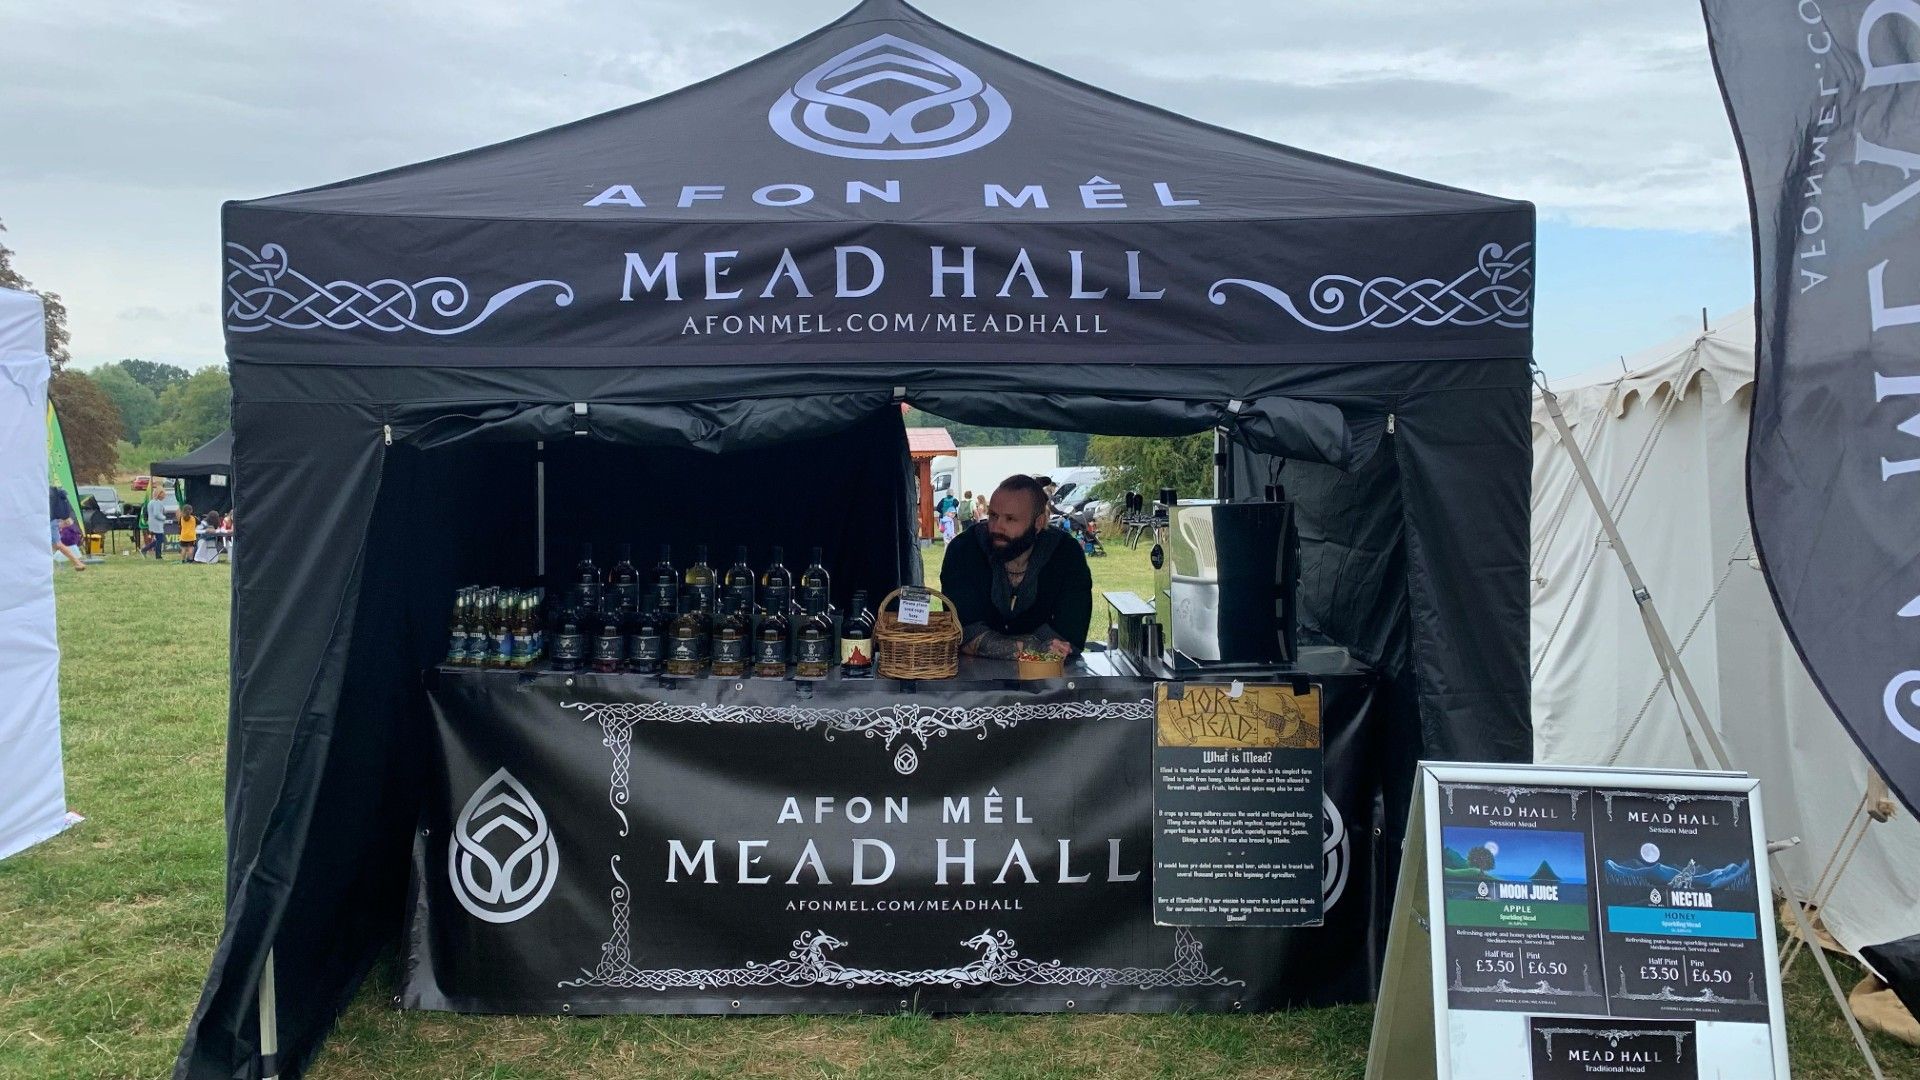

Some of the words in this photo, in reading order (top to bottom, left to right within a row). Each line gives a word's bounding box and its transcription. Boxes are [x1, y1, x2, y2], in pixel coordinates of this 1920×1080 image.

[582, 180, 900, 208] AFON
[983, 177, 1201, 209] MÊL
[620, 245, 885, 301] MEAD
[930, 245, 1166, 301] HALL
[681, 312, 1108, 336] AFONMEL.COM/MEADHALL
[1187, 712, 1253, 742] MEAD
[1203, 751, 1228, 763] What
[1232, 751, 1240, 763] is
[1242, 751, 1272, 764] Mead?
[777, 796, 909, 824] AFON
[942, 787, 1034, 824] MÊL
[1468, 804, 1513, 816] MEAD
[1519, 807, 1559, 818] HALL
[1489, 820, 1516, 828] Session
[1628, 812, 1672, 824] MEAD
[1678, 814, 1720, 826] HALL
[665, 838, 896, 885] MEAD
[934, 837, 1141, 885] HALL
[1500, 884, 1528, 900] MOON
[1530, 885, 1559, 900] JUICE
[1671, 890, 1713, 908] NECTAR
[785, 899, 1024, 912] AFONMEL.COM/MEADHALL
[1504, 905, 1532, 913] APPLE
[1476, 960, 1515, 972] £3.50
[1528, 962, 1568, 975] £6.50
[1640, 966, 1679, 980] £3.50
[1692, 969, 1732, 984] £6.50
[1568, 1050, 1615, 1062] MEAD
[1621, 1052, 1662, 1062] HALL
[1585, 1064, 1624, 1072] Traditional
